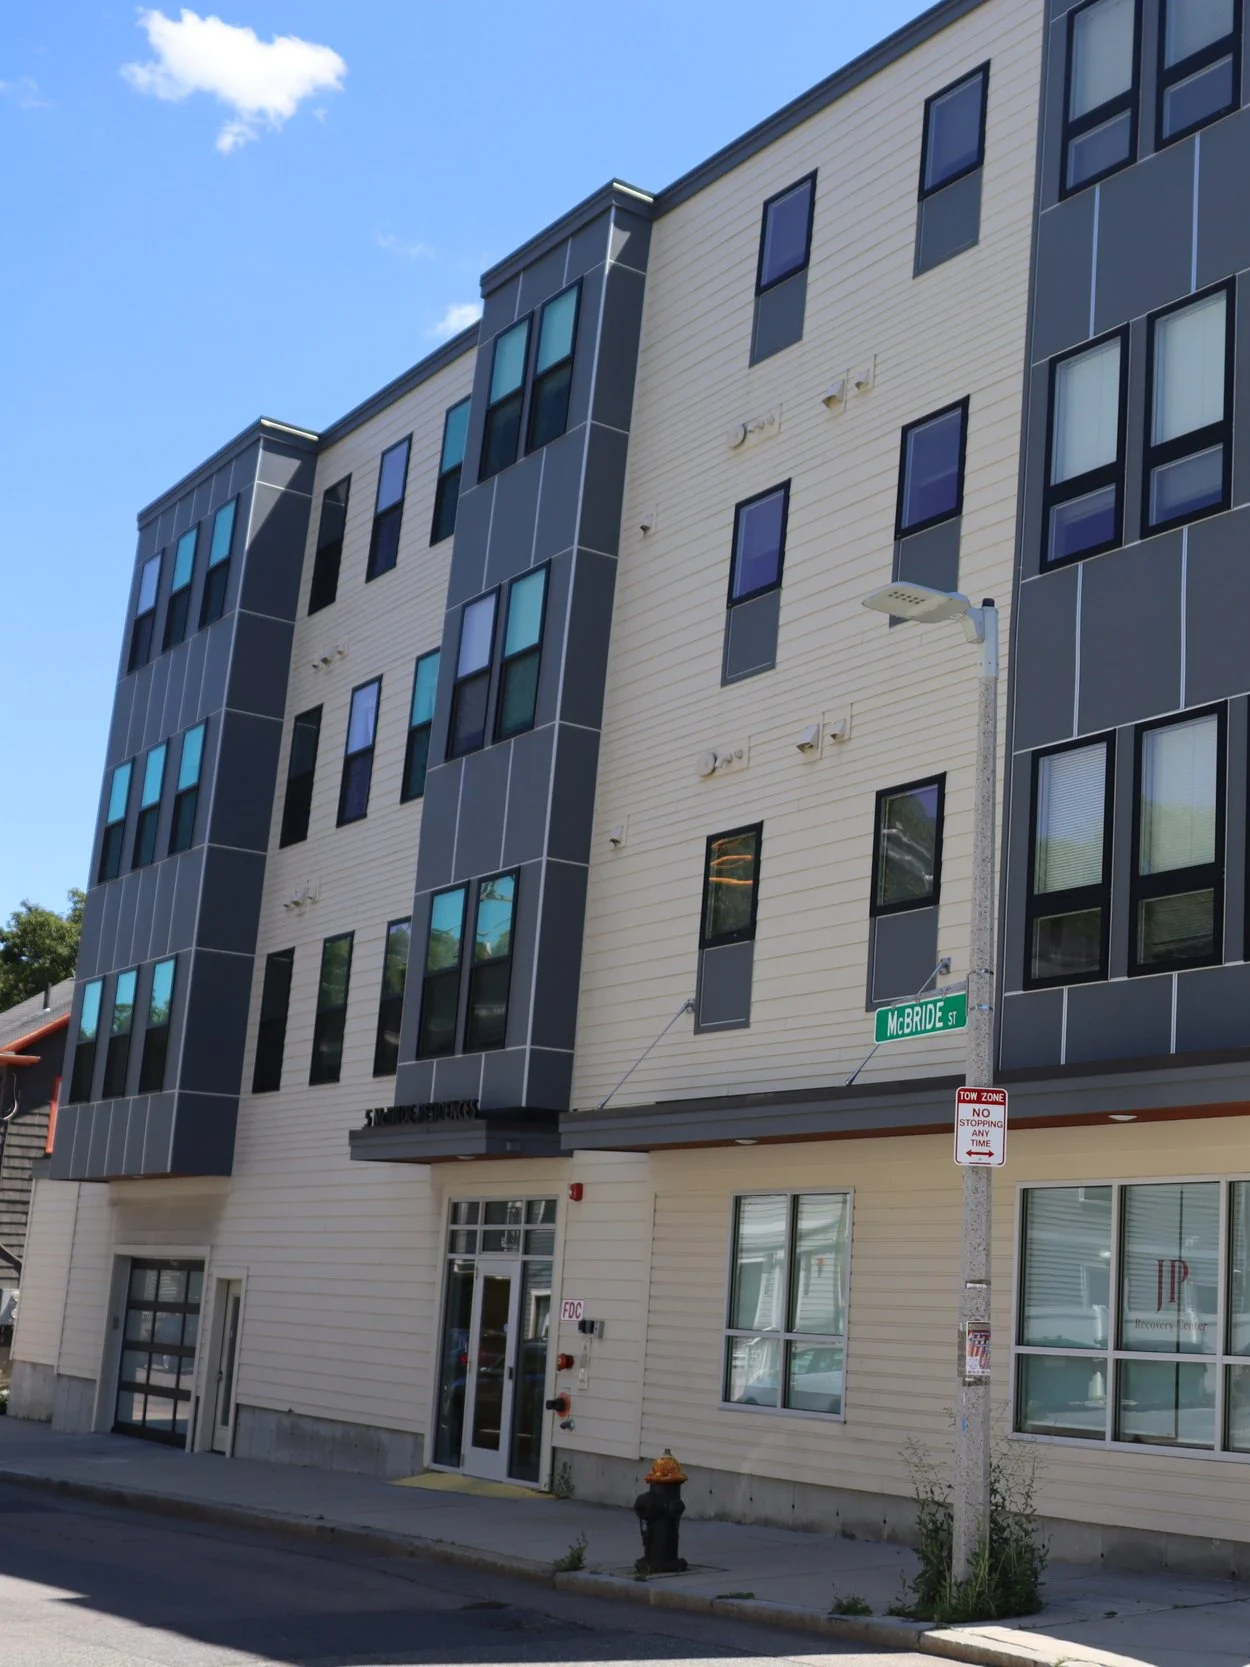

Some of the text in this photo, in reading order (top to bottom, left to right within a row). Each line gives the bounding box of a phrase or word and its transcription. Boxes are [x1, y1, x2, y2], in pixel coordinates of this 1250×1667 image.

[887, 1001, 957, 1037] McBRIDE ST
[960, 1092, 1004, 1103] TOW ZONE
[972, 1108, 991, 1118] NO
[960, 1119, 1004, 1129] STOPPING
[971, 1129, 990, 1138] ANY
[970, 1139, 992, 1148] TIME
[1155, 1259, 1189, 1314] JP
[563, 1301, 582, 1319] FDC
[1135, 1319, 1175, 1332] Recovery
